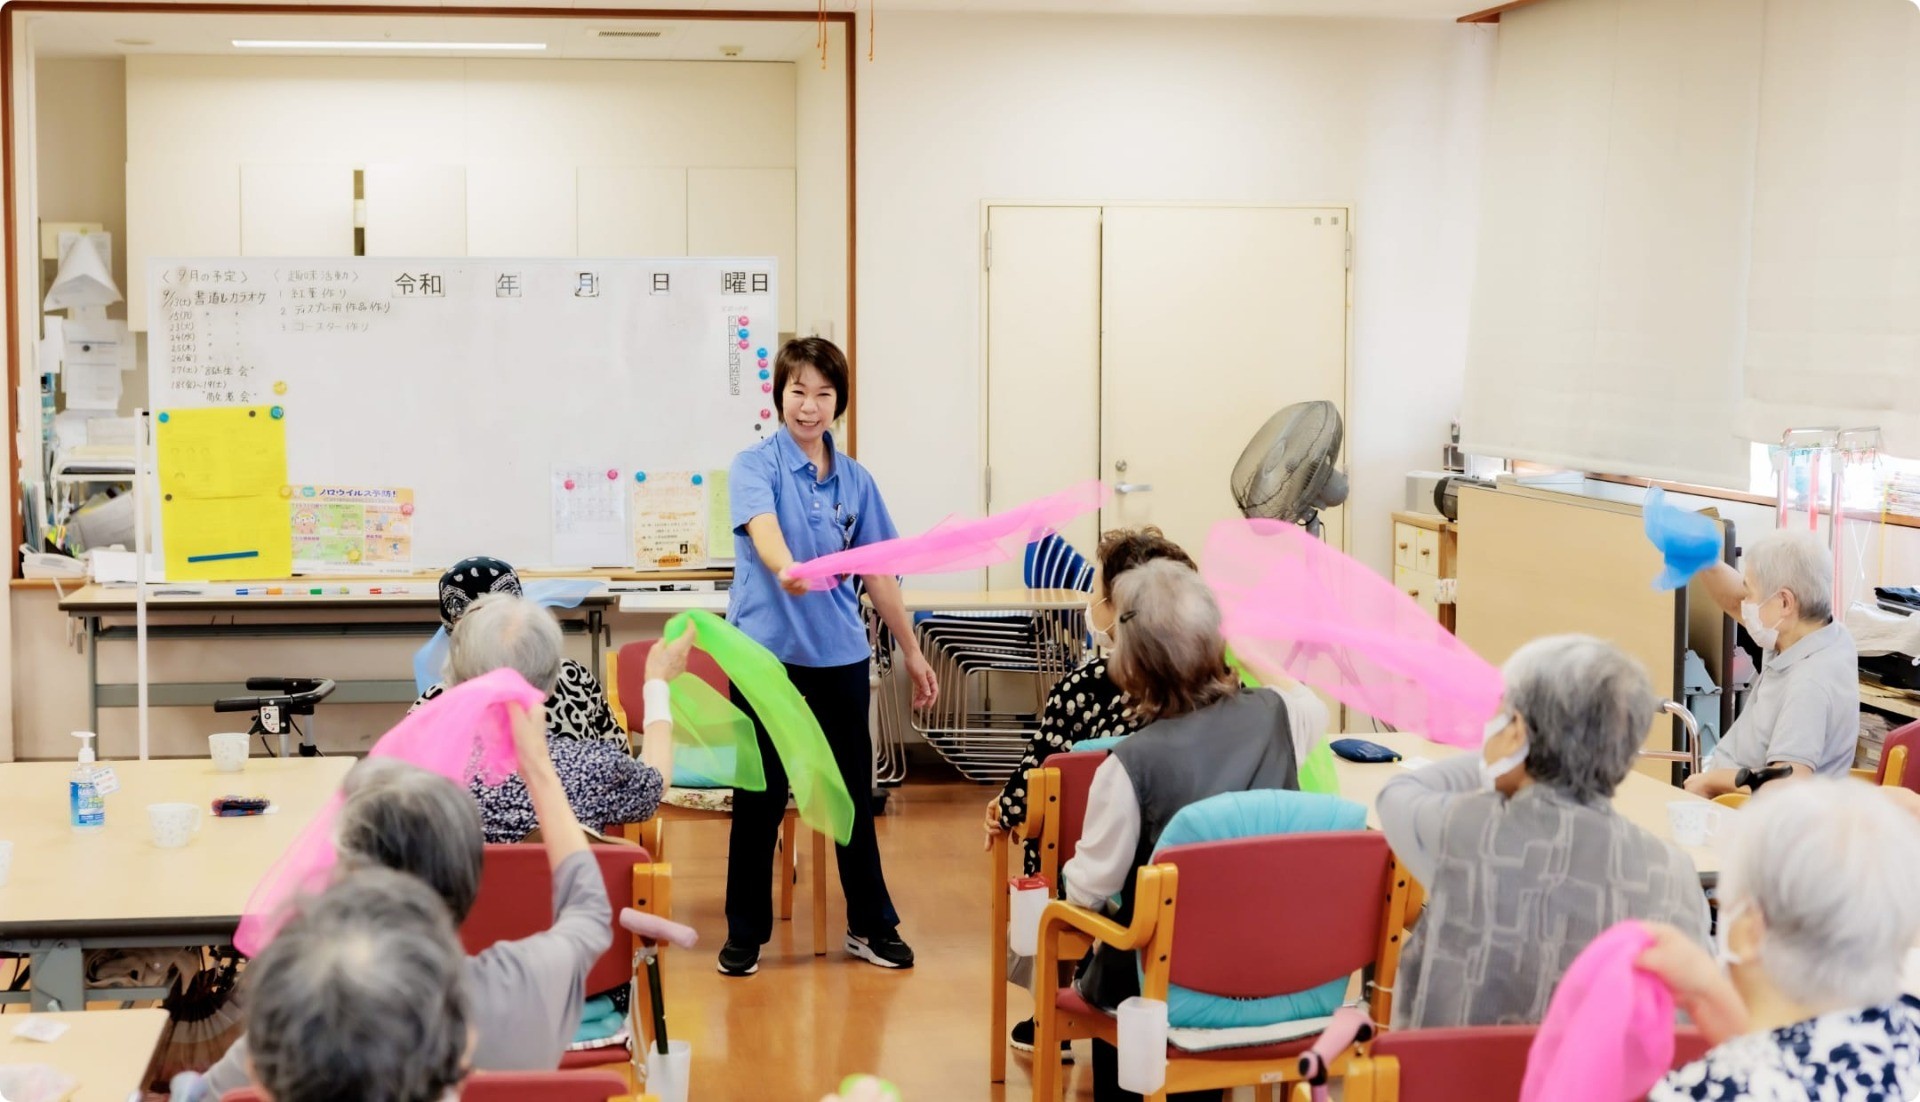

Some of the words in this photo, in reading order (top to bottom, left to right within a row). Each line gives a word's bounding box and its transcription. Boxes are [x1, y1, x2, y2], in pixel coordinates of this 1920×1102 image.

[395, 272, 441, 295] 令和
[497, 273, 519, 295] 年
[579, 273, 595, 294] 月
[654, 273, 669, 292] 日
[725, 272, 768, 293] 曜日
